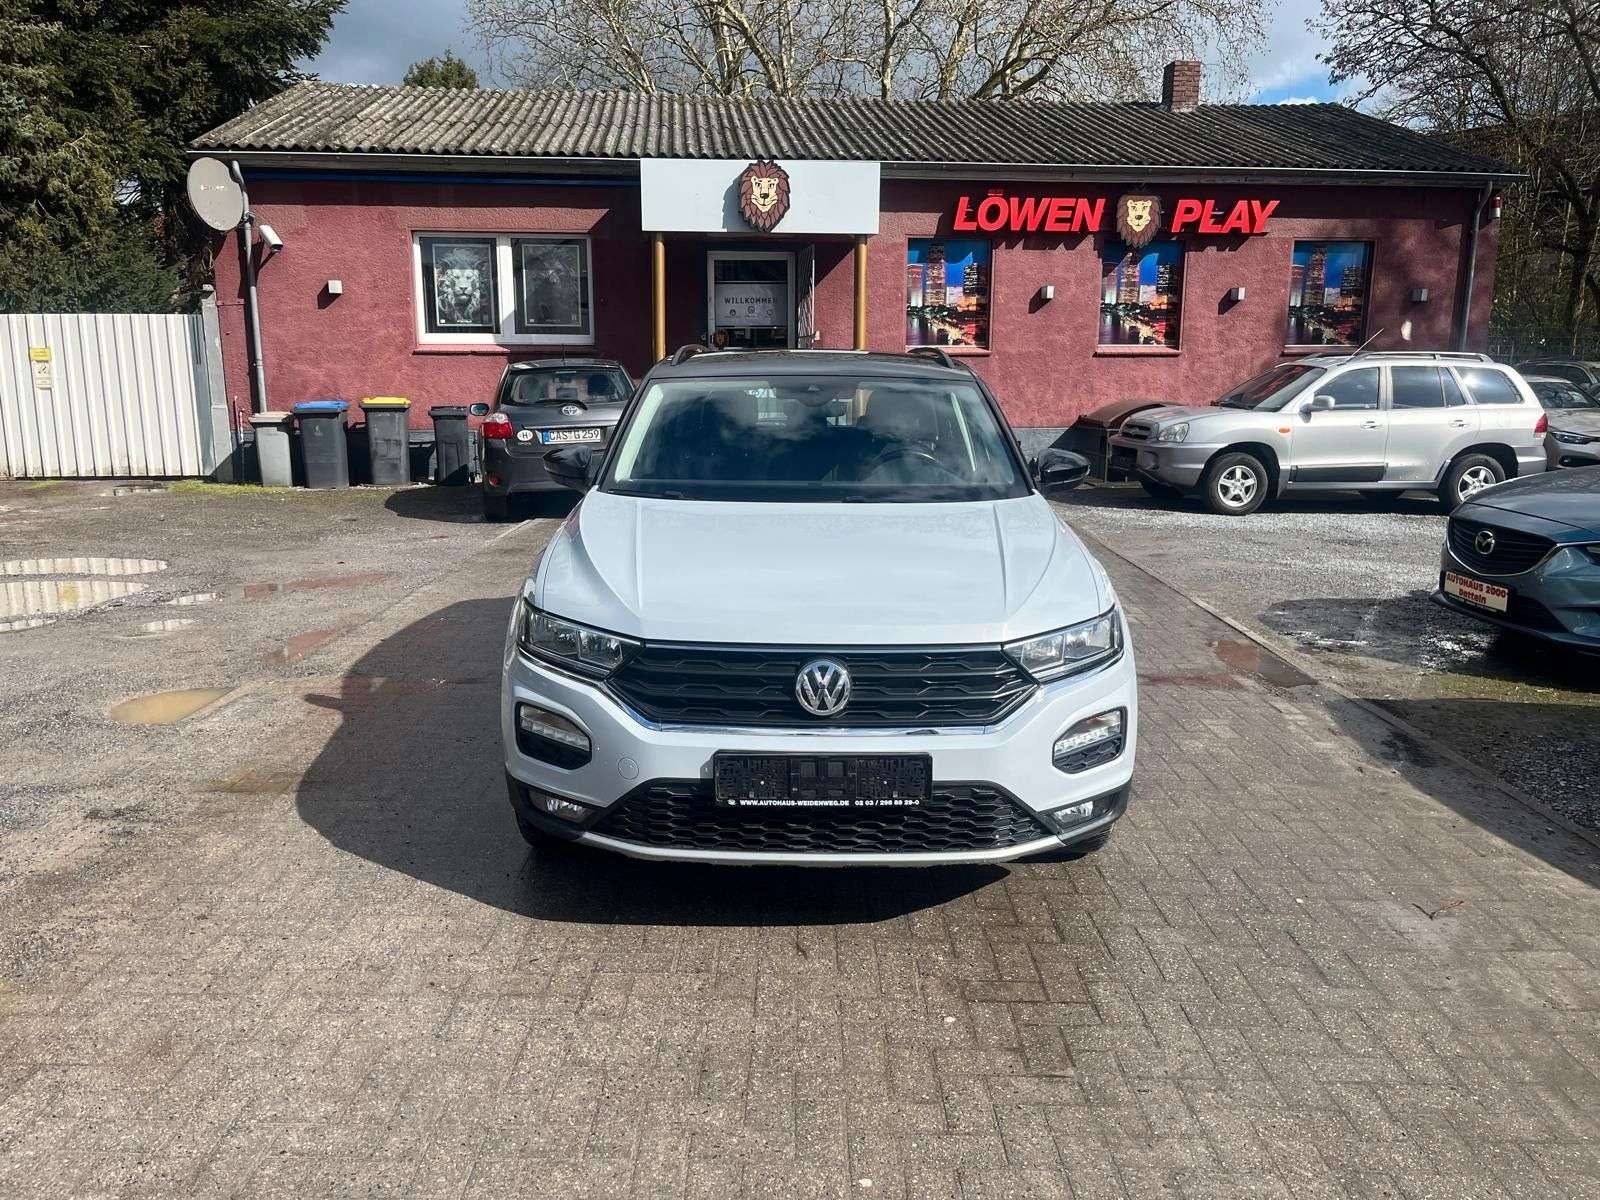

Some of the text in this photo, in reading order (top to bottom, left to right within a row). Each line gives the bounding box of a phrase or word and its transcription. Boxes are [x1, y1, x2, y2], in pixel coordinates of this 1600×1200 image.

[953, 190, 1280, 234] LÖWEN PLAY
[724, 296, 777, 304] WILLKOMMEN
[549, 429, 600, 441] CAS G 259
[1446, 573, 1506, 598] AUTOHAUS 2000
